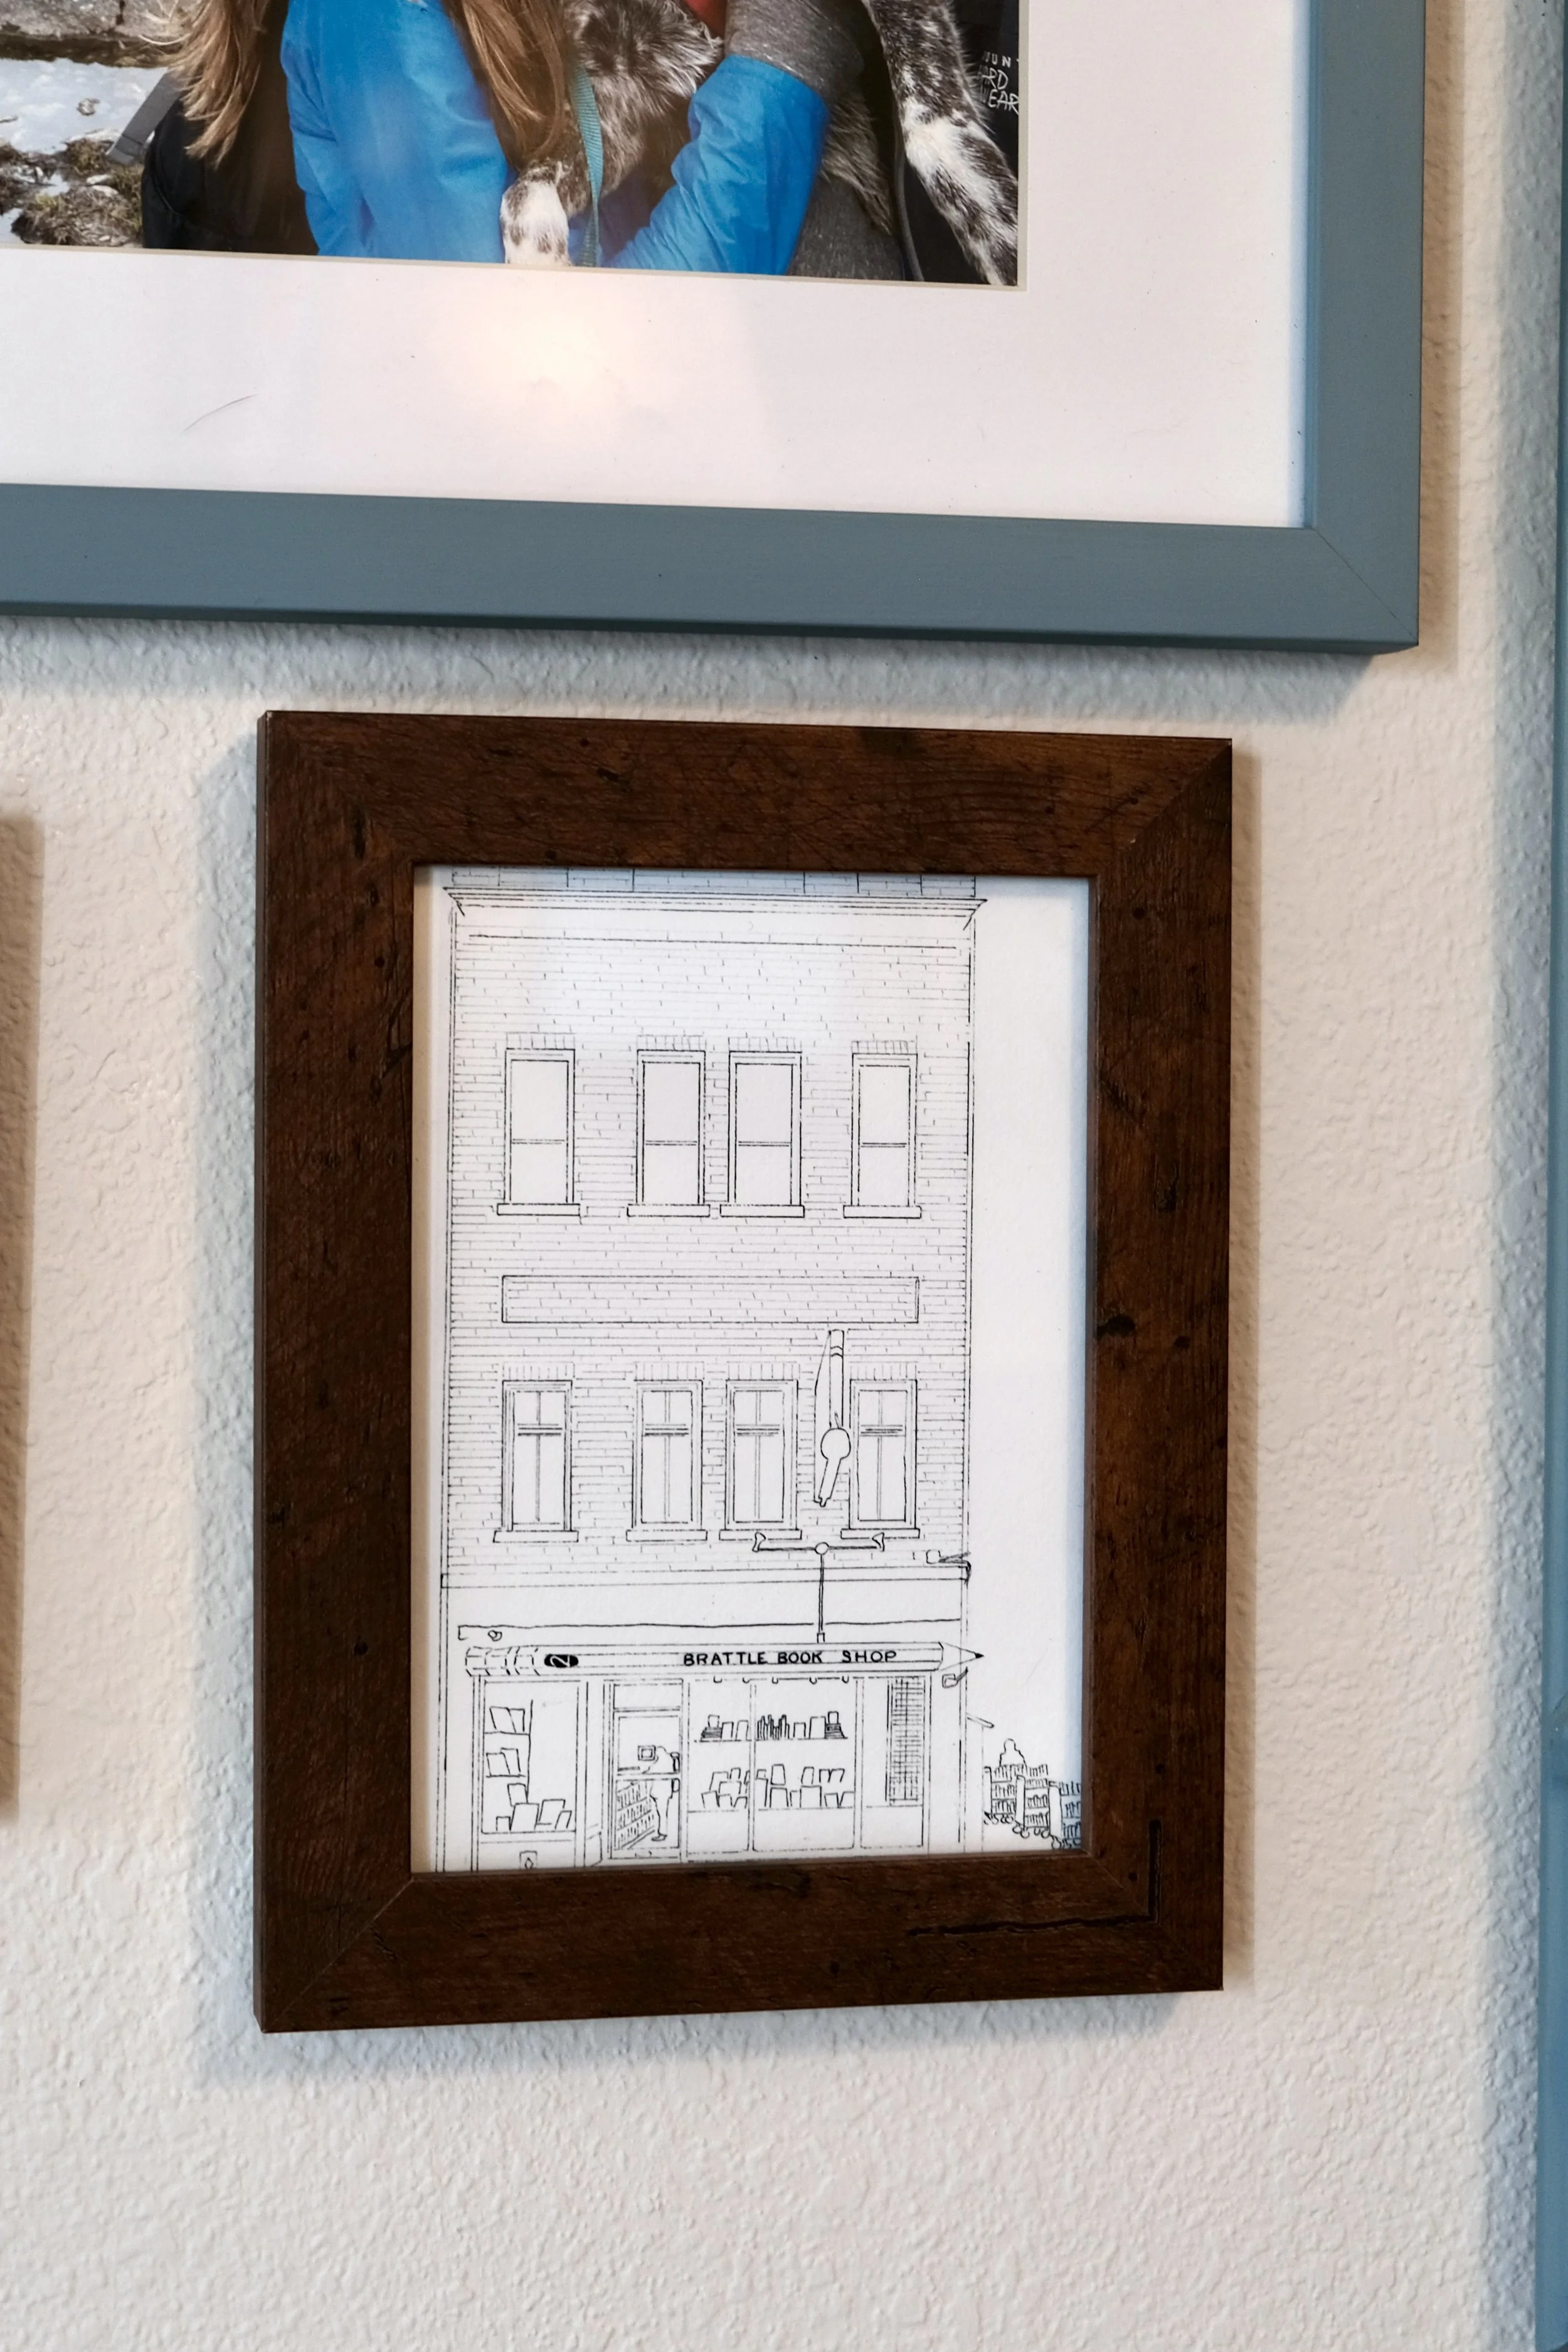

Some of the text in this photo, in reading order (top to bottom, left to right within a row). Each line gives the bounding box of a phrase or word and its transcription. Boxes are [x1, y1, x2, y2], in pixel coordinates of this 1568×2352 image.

[684, 1650, 897, 1666] BRATTLE BOOK SHOP
